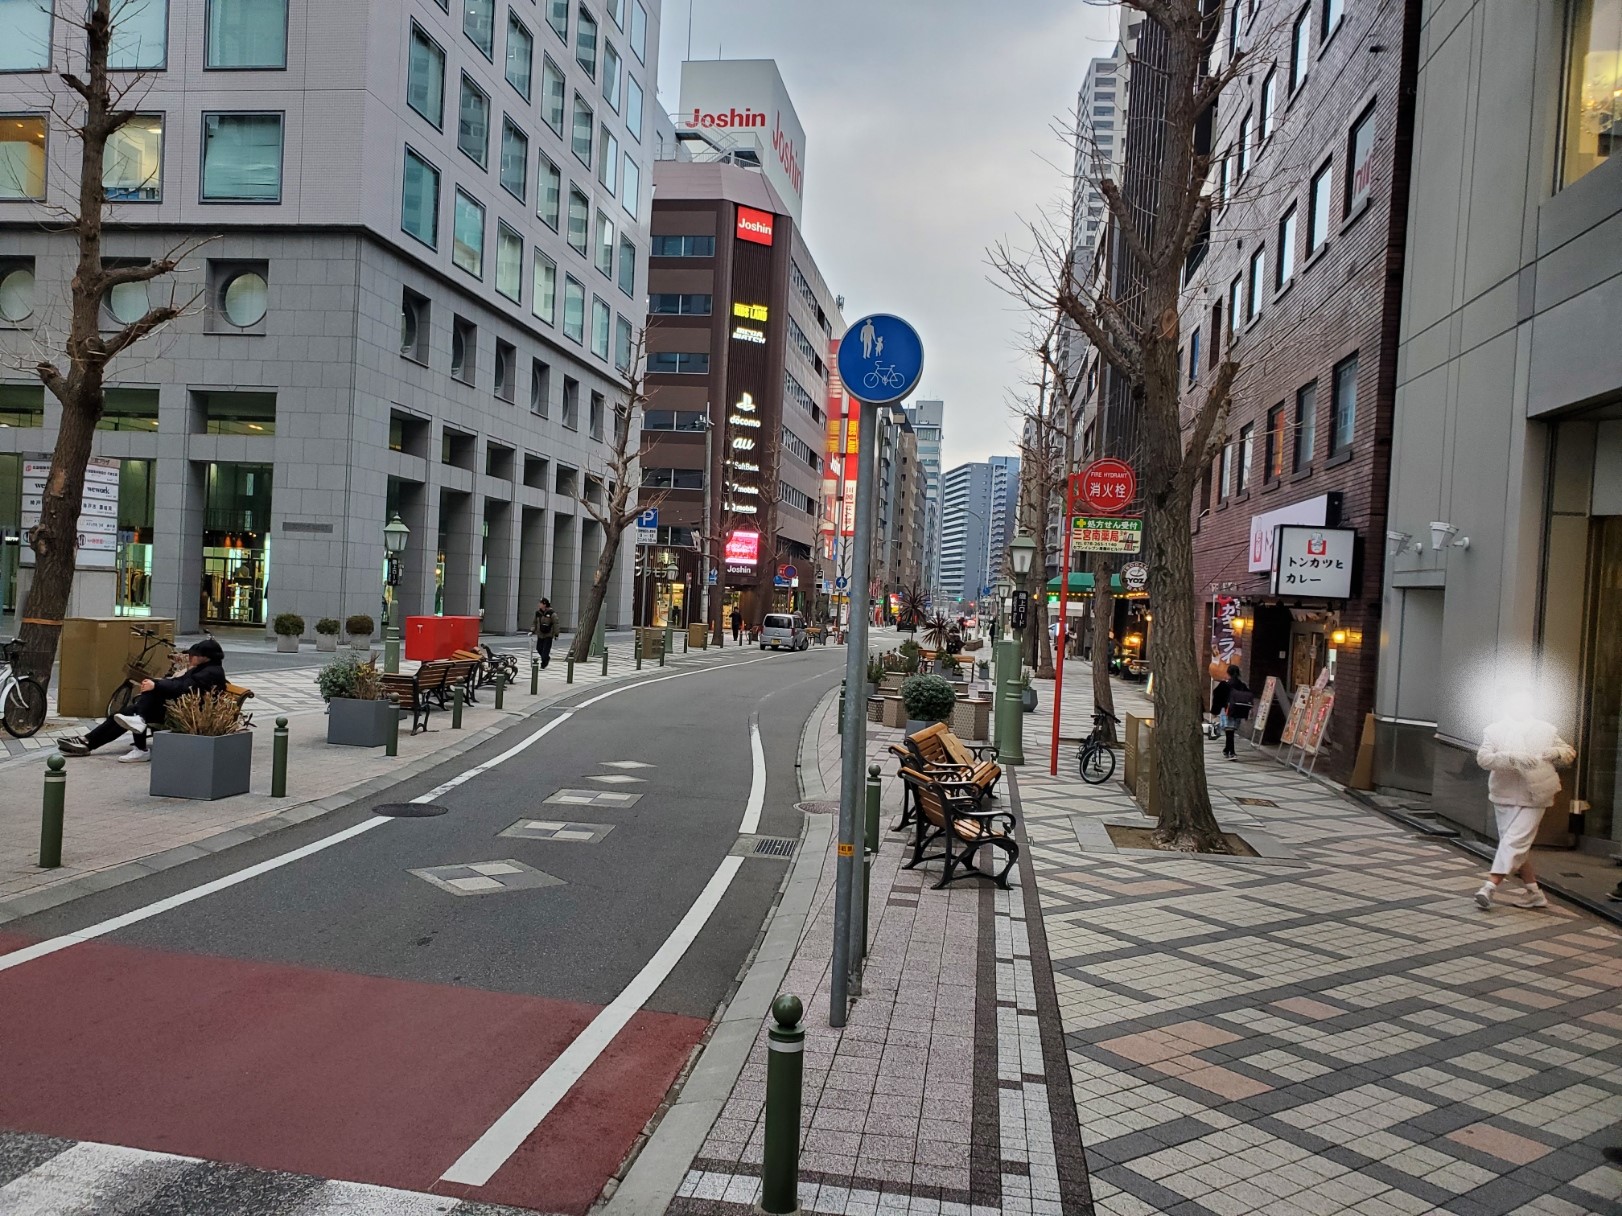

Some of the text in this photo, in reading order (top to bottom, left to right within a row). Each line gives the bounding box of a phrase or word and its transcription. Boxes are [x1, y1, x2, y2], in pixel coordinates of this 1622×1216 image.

[685, 108, 766, 128] Joshin
[772, 109, 801, 199] Joshin
[738, 218, 772, 235] Joshin
[732, 437, 756, 450] au
[1090, 482, 1126, 498] 消火栓
[1087, 520, 1138, 530] 処方せん受付
[1073, 529, 1119, 542] 三宮南薬局
[1289, 556, 1344, 569] トンカツと
[727, 565, 751, 574] Joshin
[1286, 573, 1322, 584] カレー
